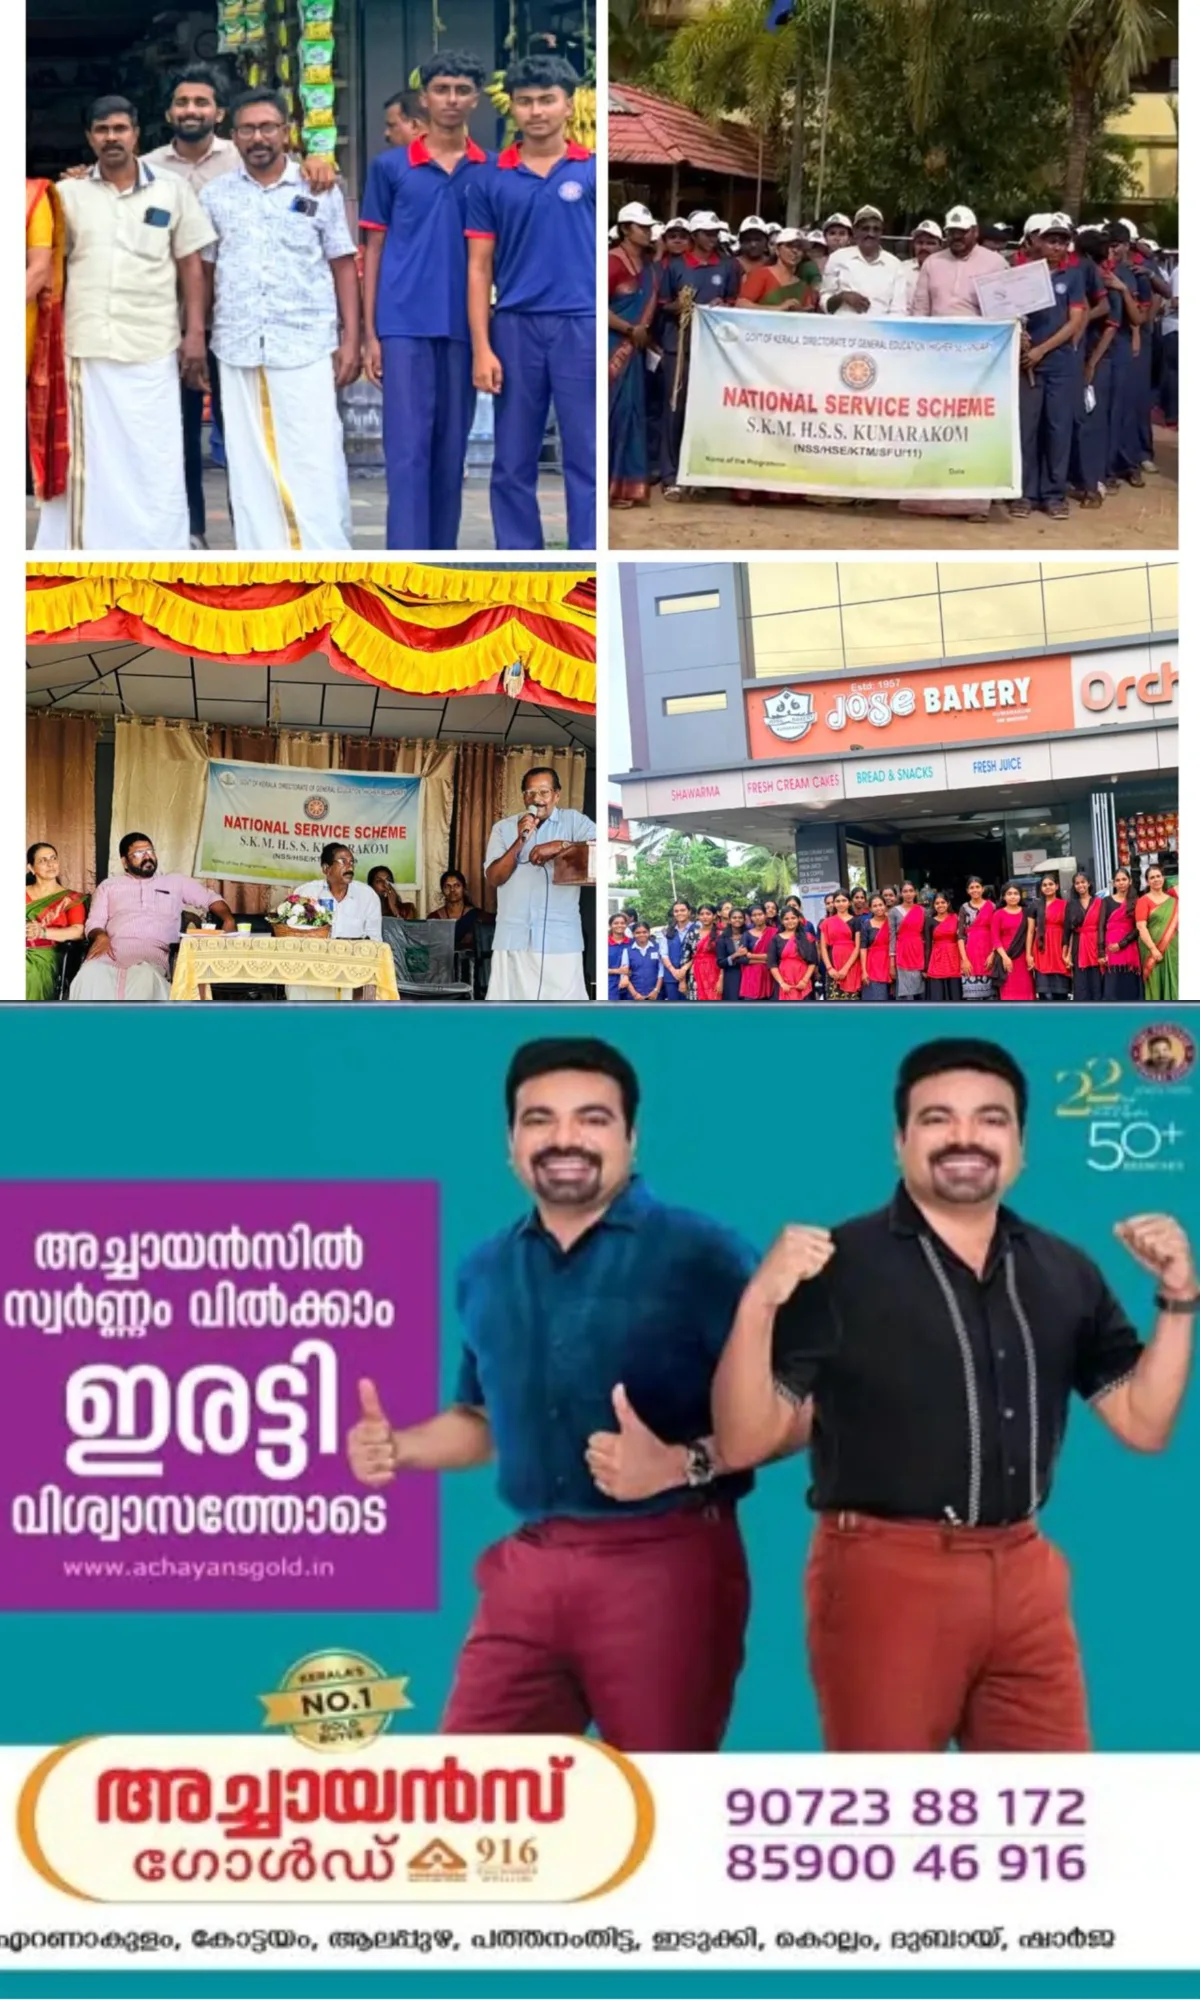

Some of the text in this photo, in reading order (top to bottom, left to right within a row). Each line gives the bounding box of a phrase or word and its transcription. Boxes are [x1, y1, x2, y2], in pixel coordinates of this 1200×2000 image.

[723, 386, 996, 418] NATIONAL SERVICE SCHEME
[746, 418, 969, 443] S.K.M. H.S.S. KUMARAKOM
[878, 679, 901, 689] 1957
[924, 676, 1031, 714] BAKERY
[856, 766, 934, 784] BREAD & SNACKS
[973, 757, 1022, 774] FRESH JUICE
[671, 785, 721, 801] SHAWARMA
[747, 773, 840, 795] FRESH CREAM CAKES
[223, 814, 407, 839] NATIONAL SERVICE SCHEME
[240, 836, 275, 849] S.K.M.
[277, 839, 309, 852] H.S.S.
[1055, 1057, 1122, 1117] 22
[1086, 1121, 1185, 1171] 50+
[34, 1223, 364, 1281] അച്ചായൻസിൽ
[3, 1280, 395, 1338] സ്വർണ്ണം വിൽക്കാം
[65, 1338, 339, 1481] ഇരട്ടി
[12, 1484, 388, 1542] വിശ്വാസത്തോടെ
[62, 1556, 335, 1582] www.achayansgold.in
[301, 1686, 372, 1717] NO.1
[96, 1755, 576, 1839] അച്ചായൻസ്
[725, 1787, 1087, 1827] 90723 88 172
[133, 1833, 400, 1883] ഗോൾഡ്
[475, 1834, 539, 1865] 916
[725, 1843, 1087, 1882] 85900 46 916
